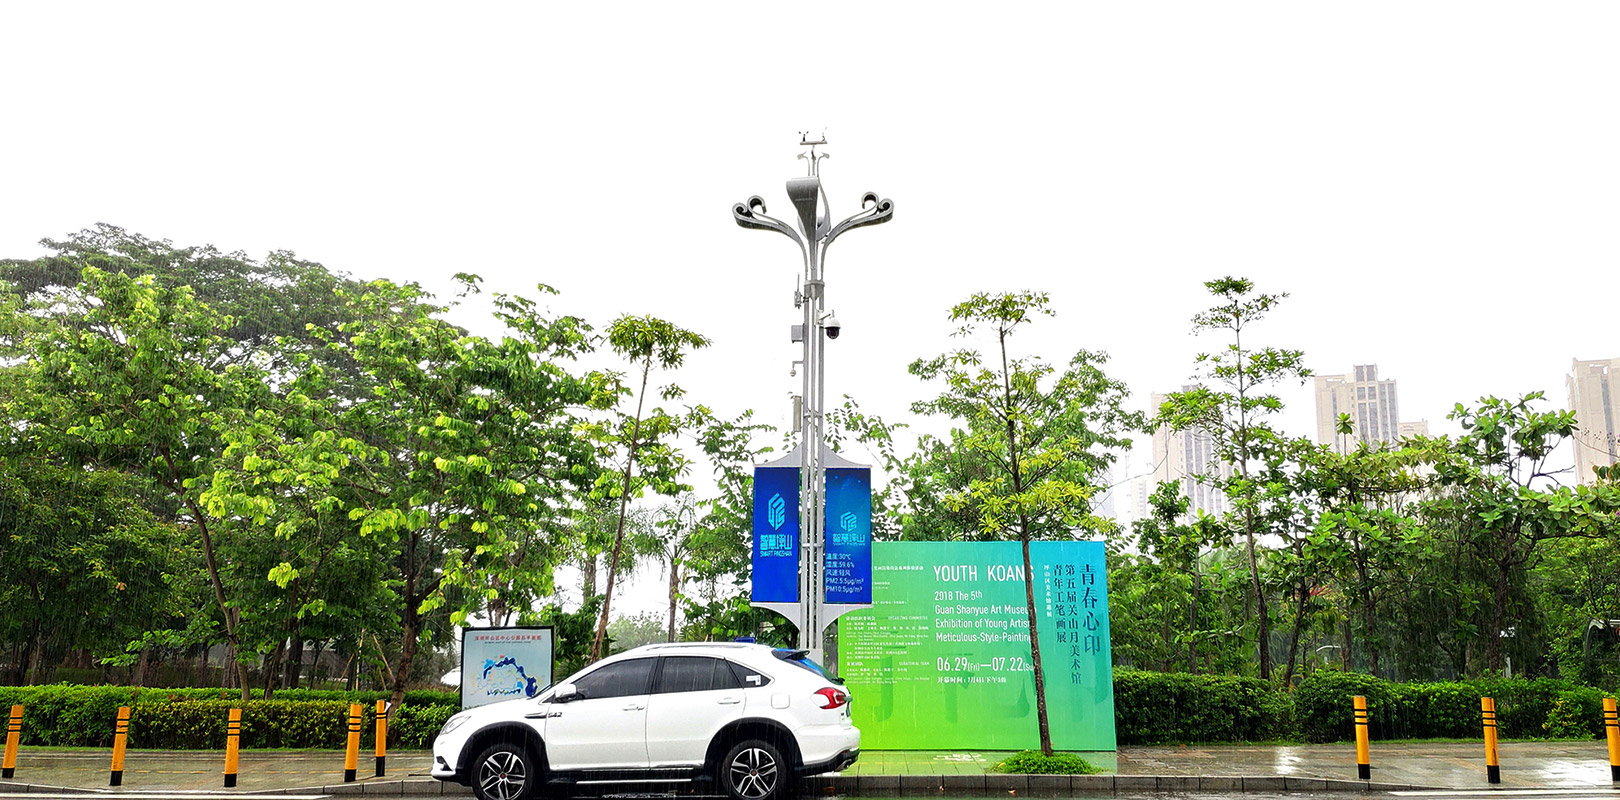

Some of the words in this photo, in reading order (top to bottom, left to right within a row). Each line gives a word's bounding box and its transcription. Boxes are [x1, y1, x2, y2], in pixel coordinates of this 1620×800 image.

[933, 564, 978, 582] YOUTH
[934, 591, 953, 601] 2018
[955, 591, 969, 601] The
[970, 590, 983, 601] 5th
[1054, 564, 1067, 643] 青年工笔画展
[935, 604, 954, 615] Guan
[956, 604, 989, 616] Shanyue
[990, 604, 1002, 615] Art
[1004, 604, 1036, 615] Museu
[1080, 563, 1100, 656] 青春心印
[935, 618, 973, 628] Exhibition
[975, 618, 983, 628] of
[984, 618, 1008, 630] Young
[1065, 564, 1081, 685] 第五届关山月美术馆
